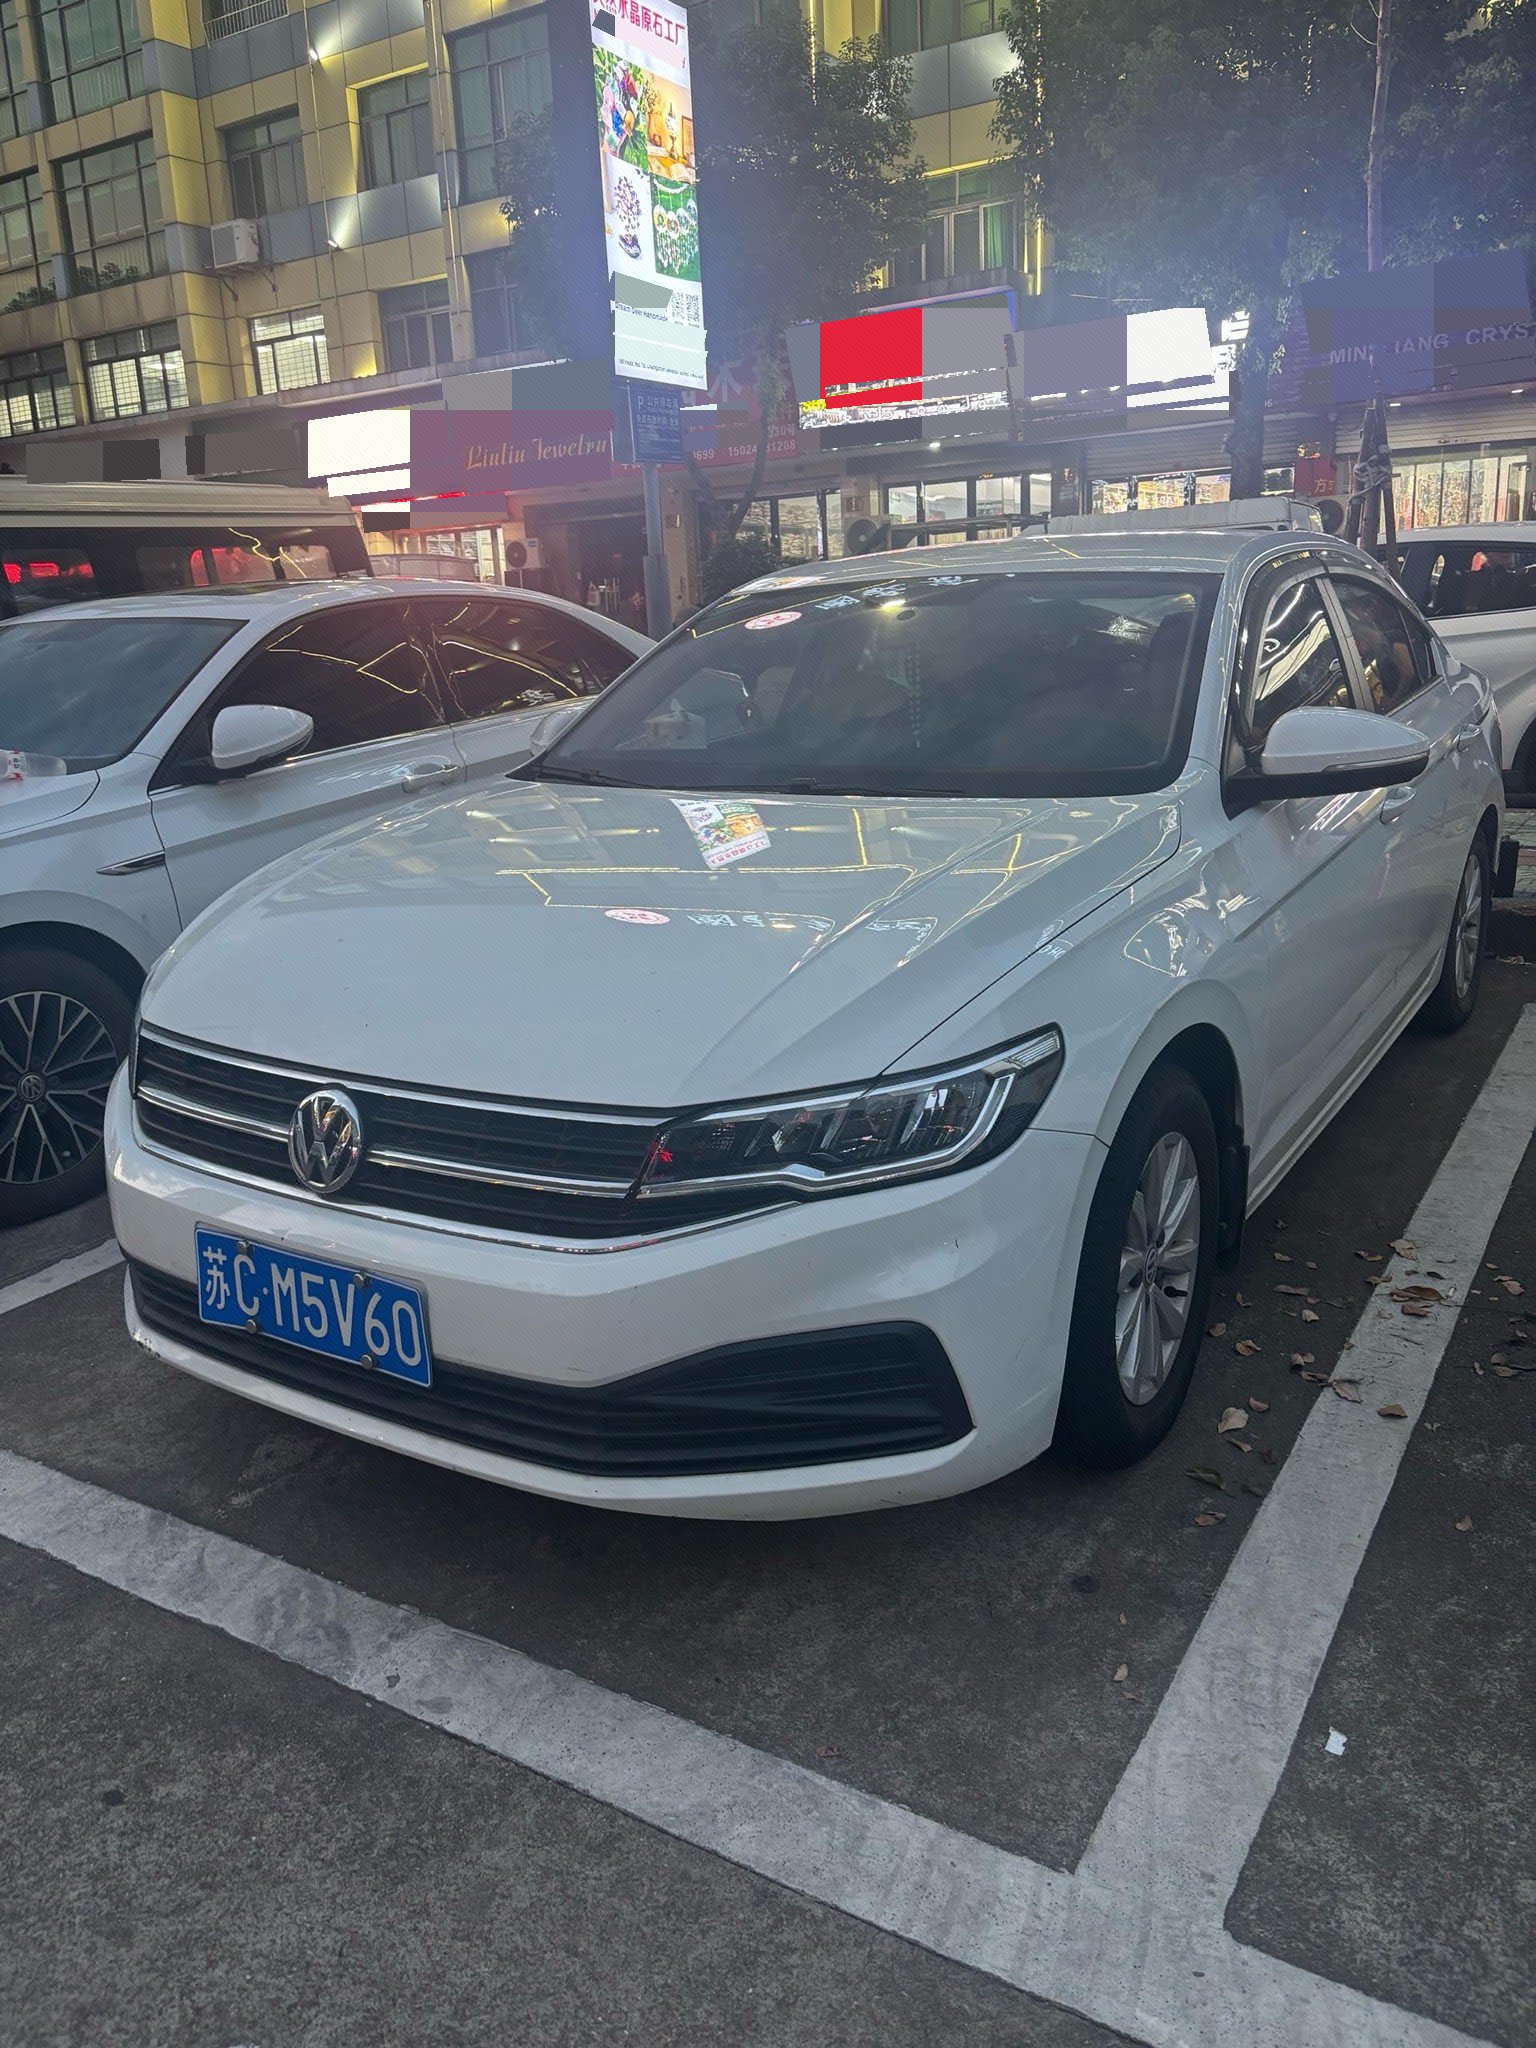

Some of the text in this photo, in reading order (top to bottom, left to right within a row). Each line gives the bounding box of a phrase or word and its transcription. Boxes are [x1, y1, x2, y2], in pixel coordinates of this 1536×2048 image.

[1465, 322, 1536, 346] CRYS
[465, 442, 525, 470] Liuliu
[203, 1246, 422, 1367] 苏C·M5V60
